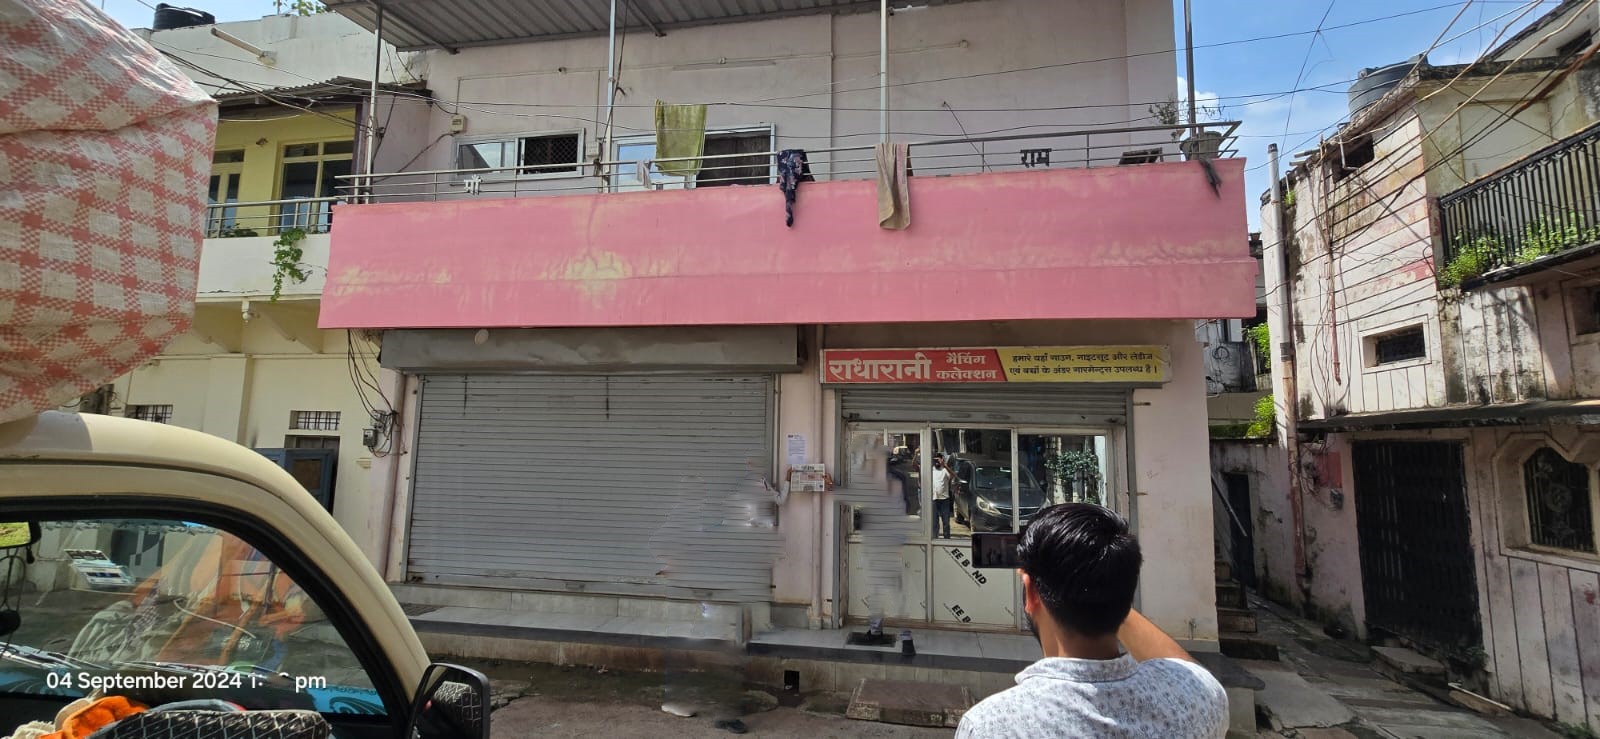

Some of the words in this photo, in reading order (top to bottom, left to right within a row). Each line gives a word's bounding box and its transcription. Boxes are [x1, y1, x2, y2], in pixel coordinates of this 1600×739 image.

[1020, 148, 1052, 168] राम
[945, 352, 985, 364] मैचिंग
[1012, 353, 1031, 362] हमारे
[1112, 352, 1127, 361] और
[828, 352, 932, 380] राधारानी
[1009, 365, 1020, 375] एवं
[1041, 365, 1050, 374] के
[1113, 366, 1143, 374] उपलब्ध
[936, 367, 997, 380] कलेक्शन
